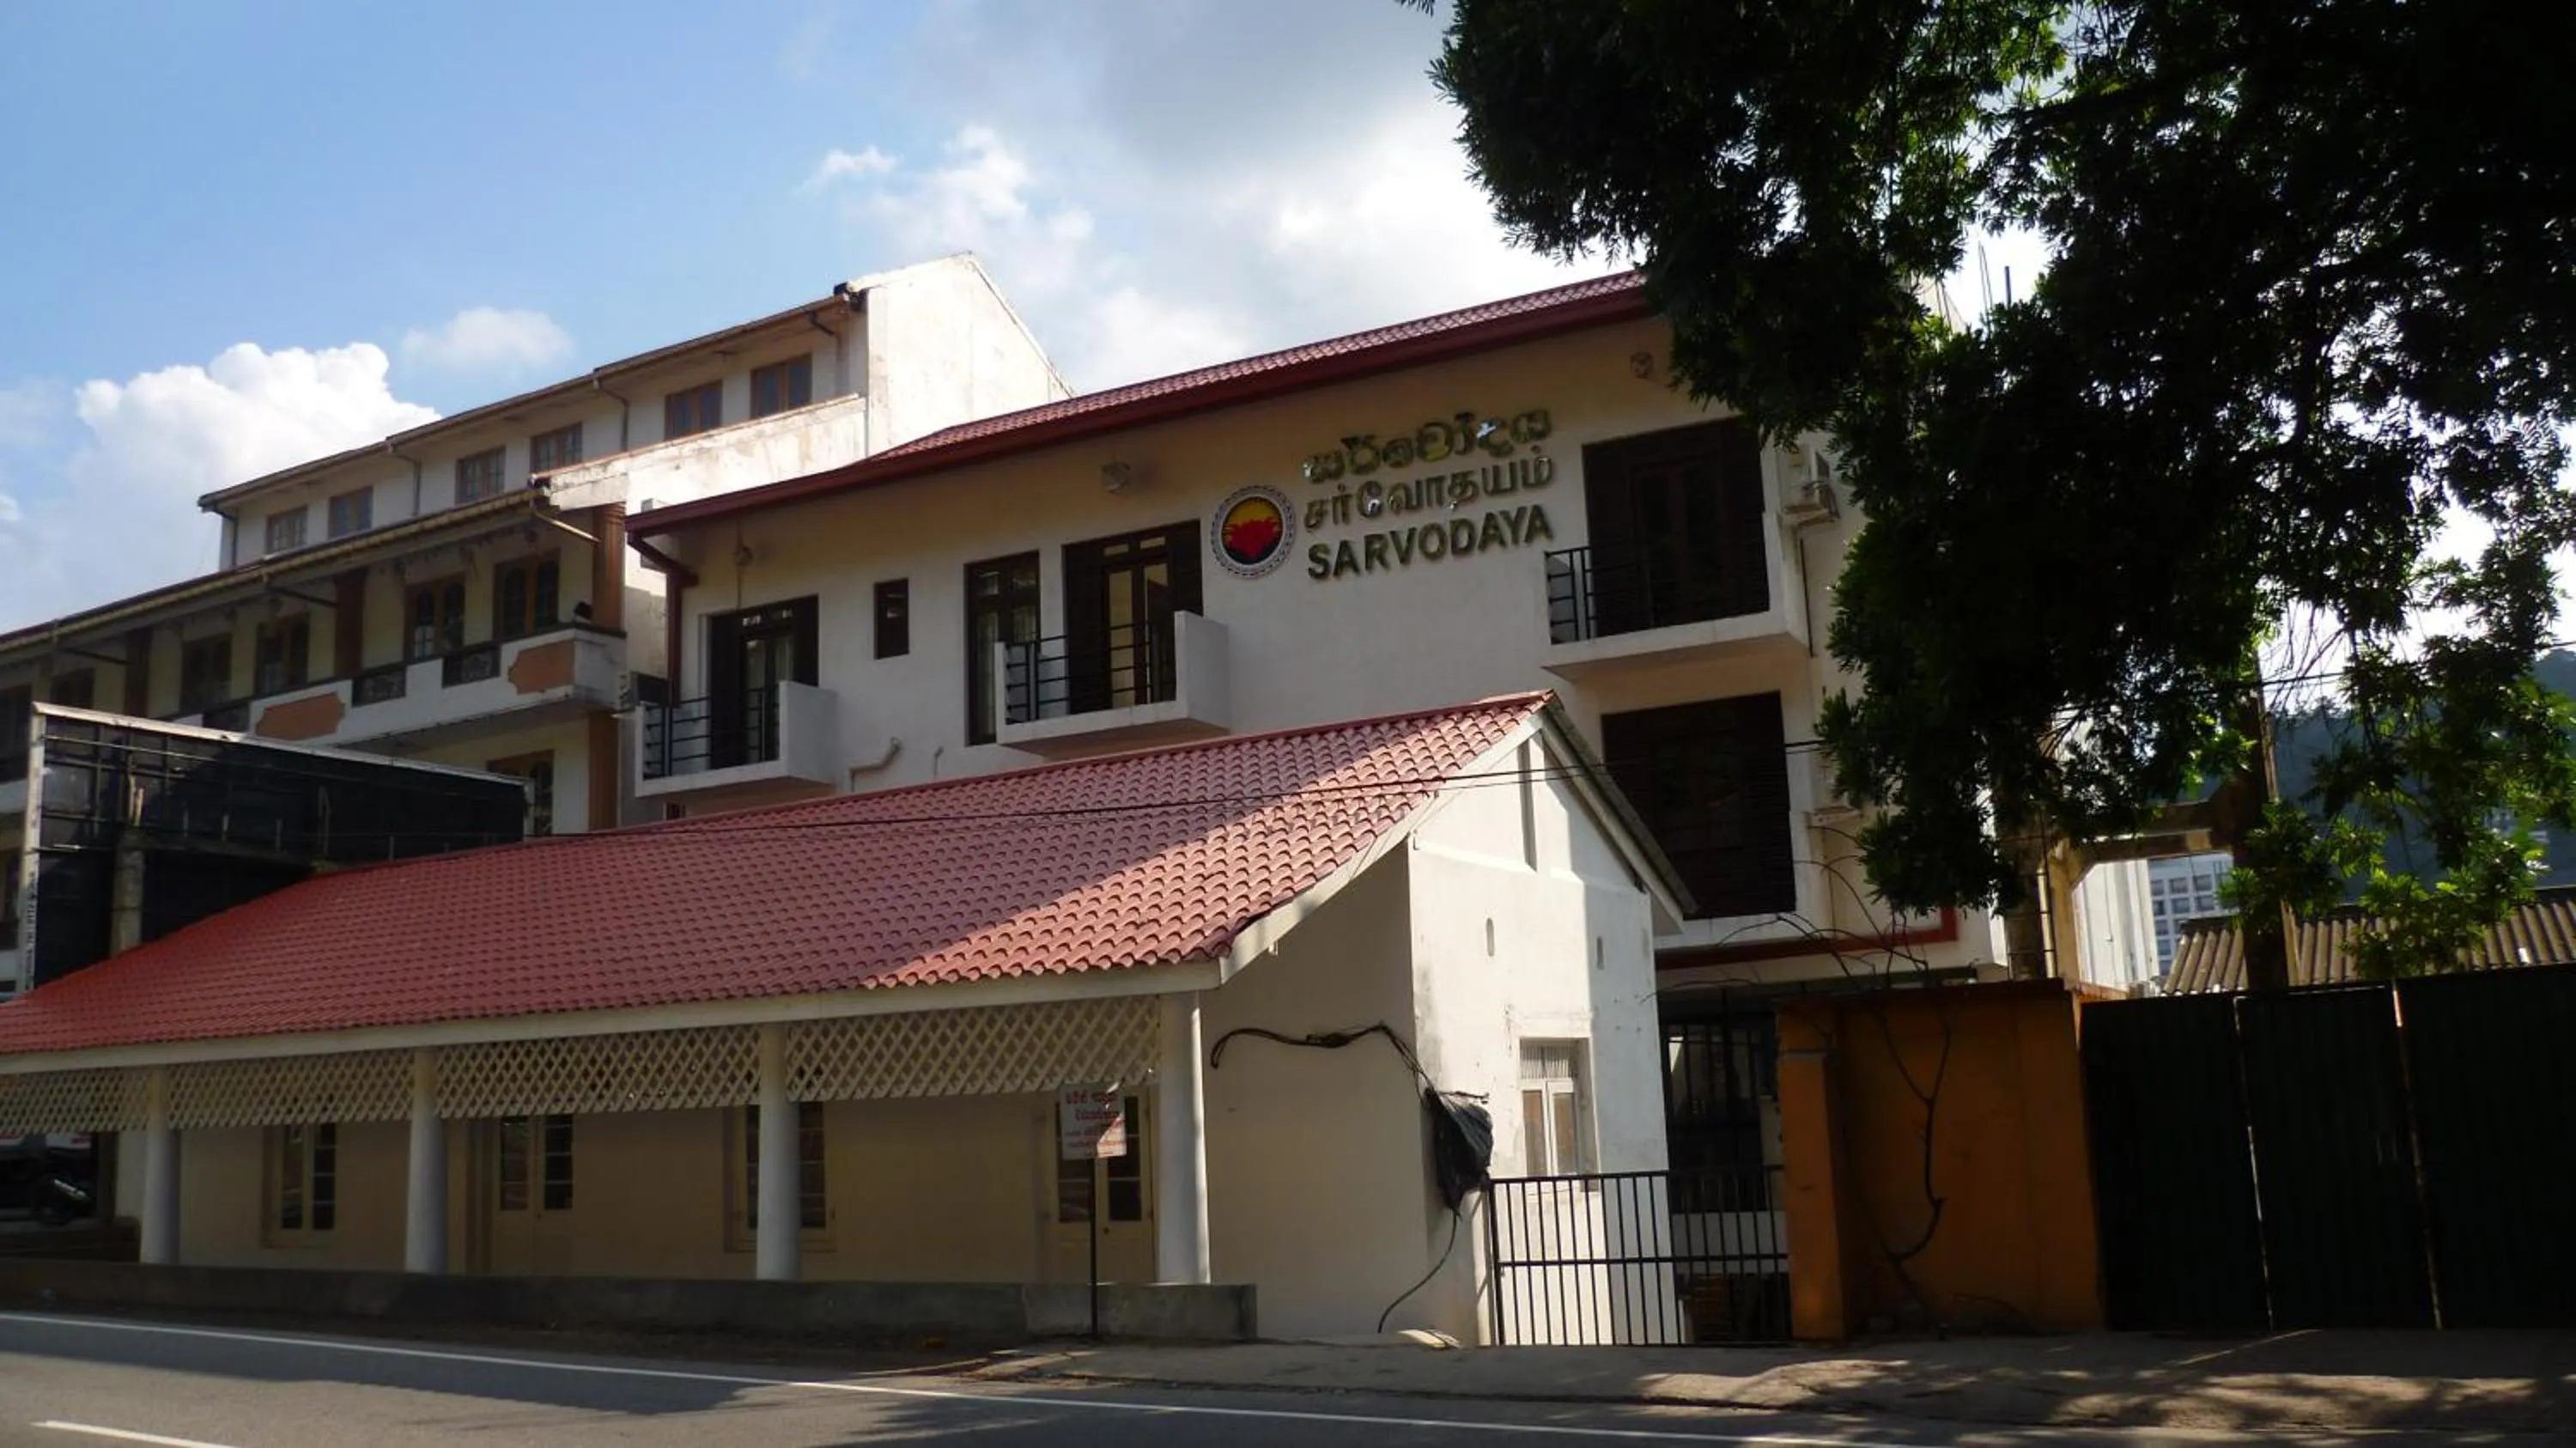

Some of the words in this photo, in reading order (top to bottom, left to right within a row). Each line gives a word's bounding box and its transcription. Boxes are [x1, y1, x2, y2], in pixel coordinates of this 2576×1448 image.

[1303, 409, 1552, 484] සර්වෝදය
[1304, 446, 1553, 531] சர்வோதயம்
[1308, 504, 1552, 580] SARVODAYA
